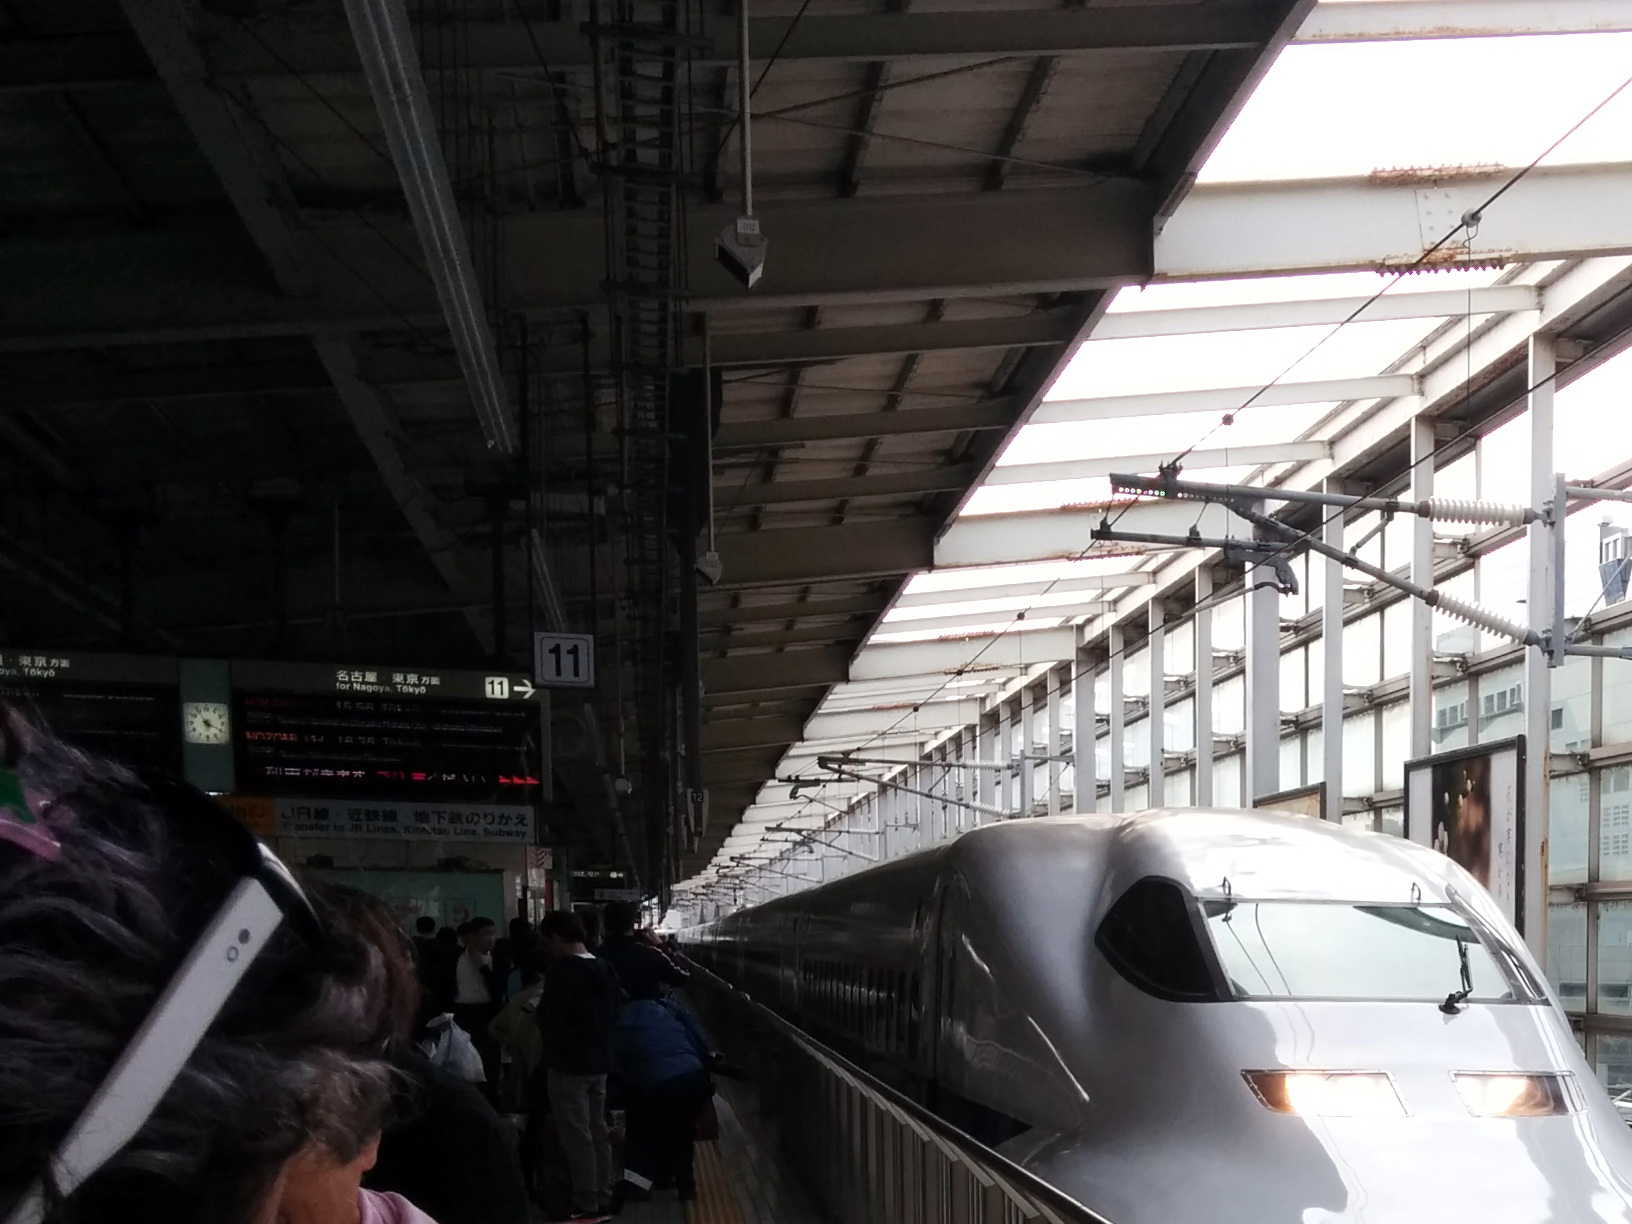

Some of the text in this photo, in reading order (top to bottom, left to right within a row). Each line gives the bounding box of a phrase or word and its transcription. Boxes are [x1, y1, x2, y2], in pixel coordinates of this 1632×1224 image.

[548, 643, 579, 677] 11
[335, 682, 350, 691] for
[488, 679, 506, 696] 11
[333, 823, 345, 832] to
[348, 823, 363, 833] JR
[366, 823, 400, 834] Lines,
[483, 827, 527, 839] Subway
